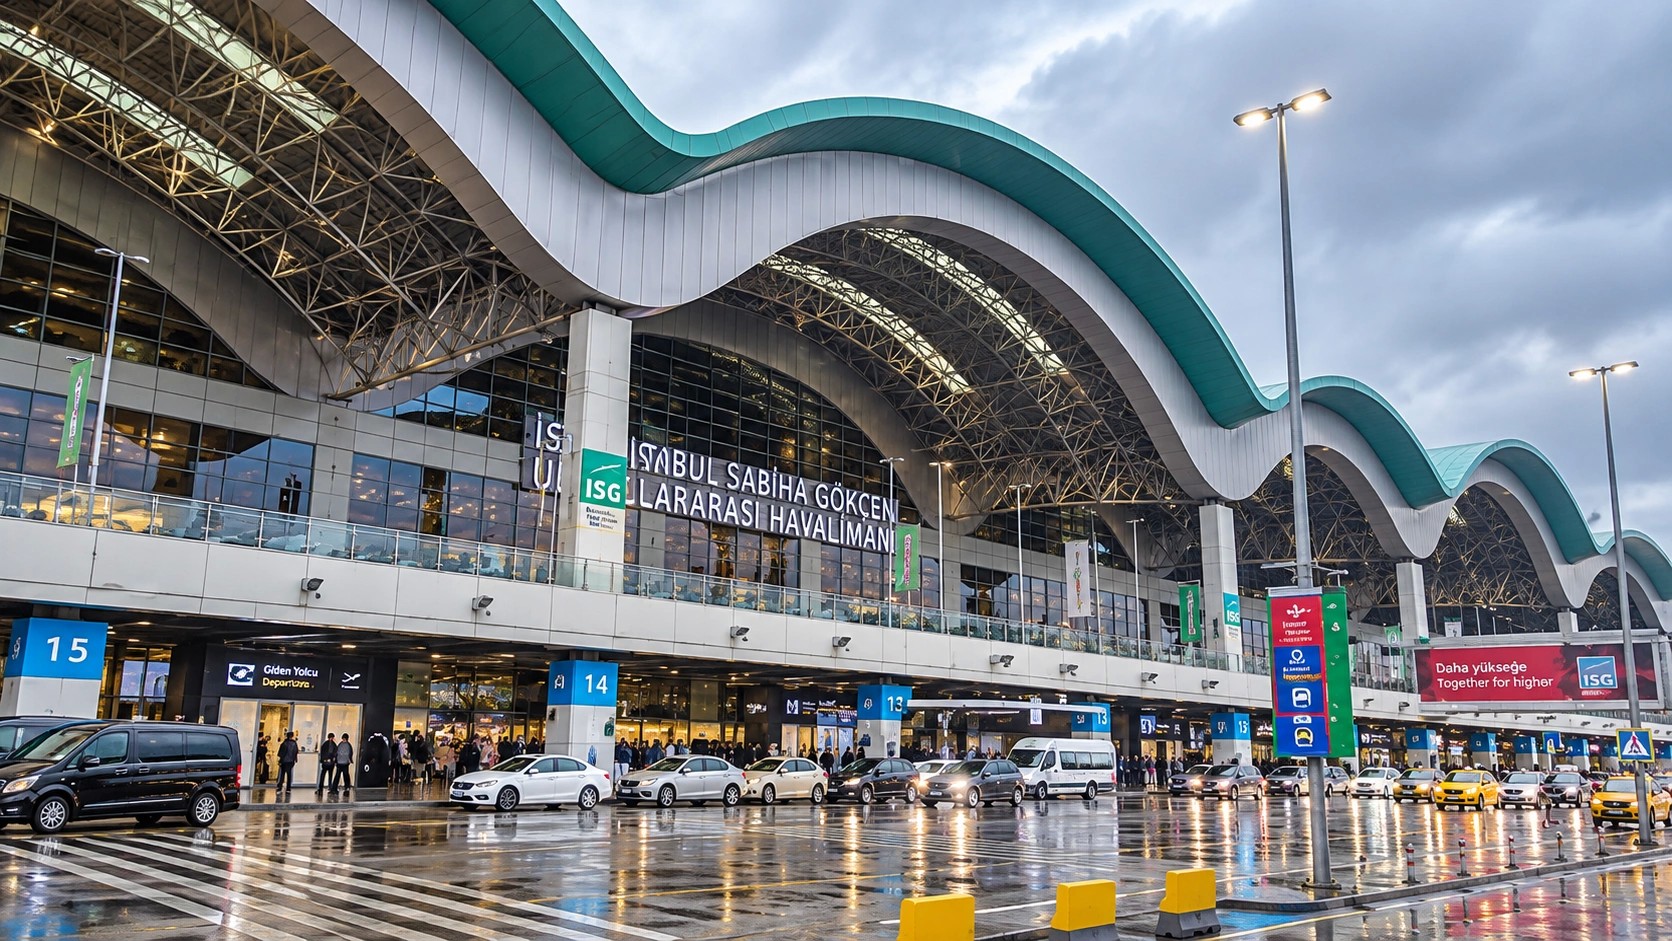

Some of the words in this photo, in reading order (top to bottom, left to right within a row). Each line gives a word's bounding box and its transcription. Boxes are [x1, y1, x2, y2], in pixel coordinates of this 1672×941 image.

[535, 411, 564, 452] İS
[726, 462, 808, 505] SABİHA
[815, 481, 895, 523] GÖKÇEN
[585, 478, 621, 503] ISG
[770, 504, 895, 554] HAVALİMANI
[47, 636, 89, 663] 15
[1435, 662, 1469, 674] Daha
[1472, 660, 1528, 676] yükseğe
[585, 673, 608, 695] 14
[1437, 677, 1490, 691] Together
[1493, 676, 1511, 688] for
[1513, 676, 1554, 691] higher
[1583, 673, 1614, 687] ISG
[887, 695, 904, 712] 13
